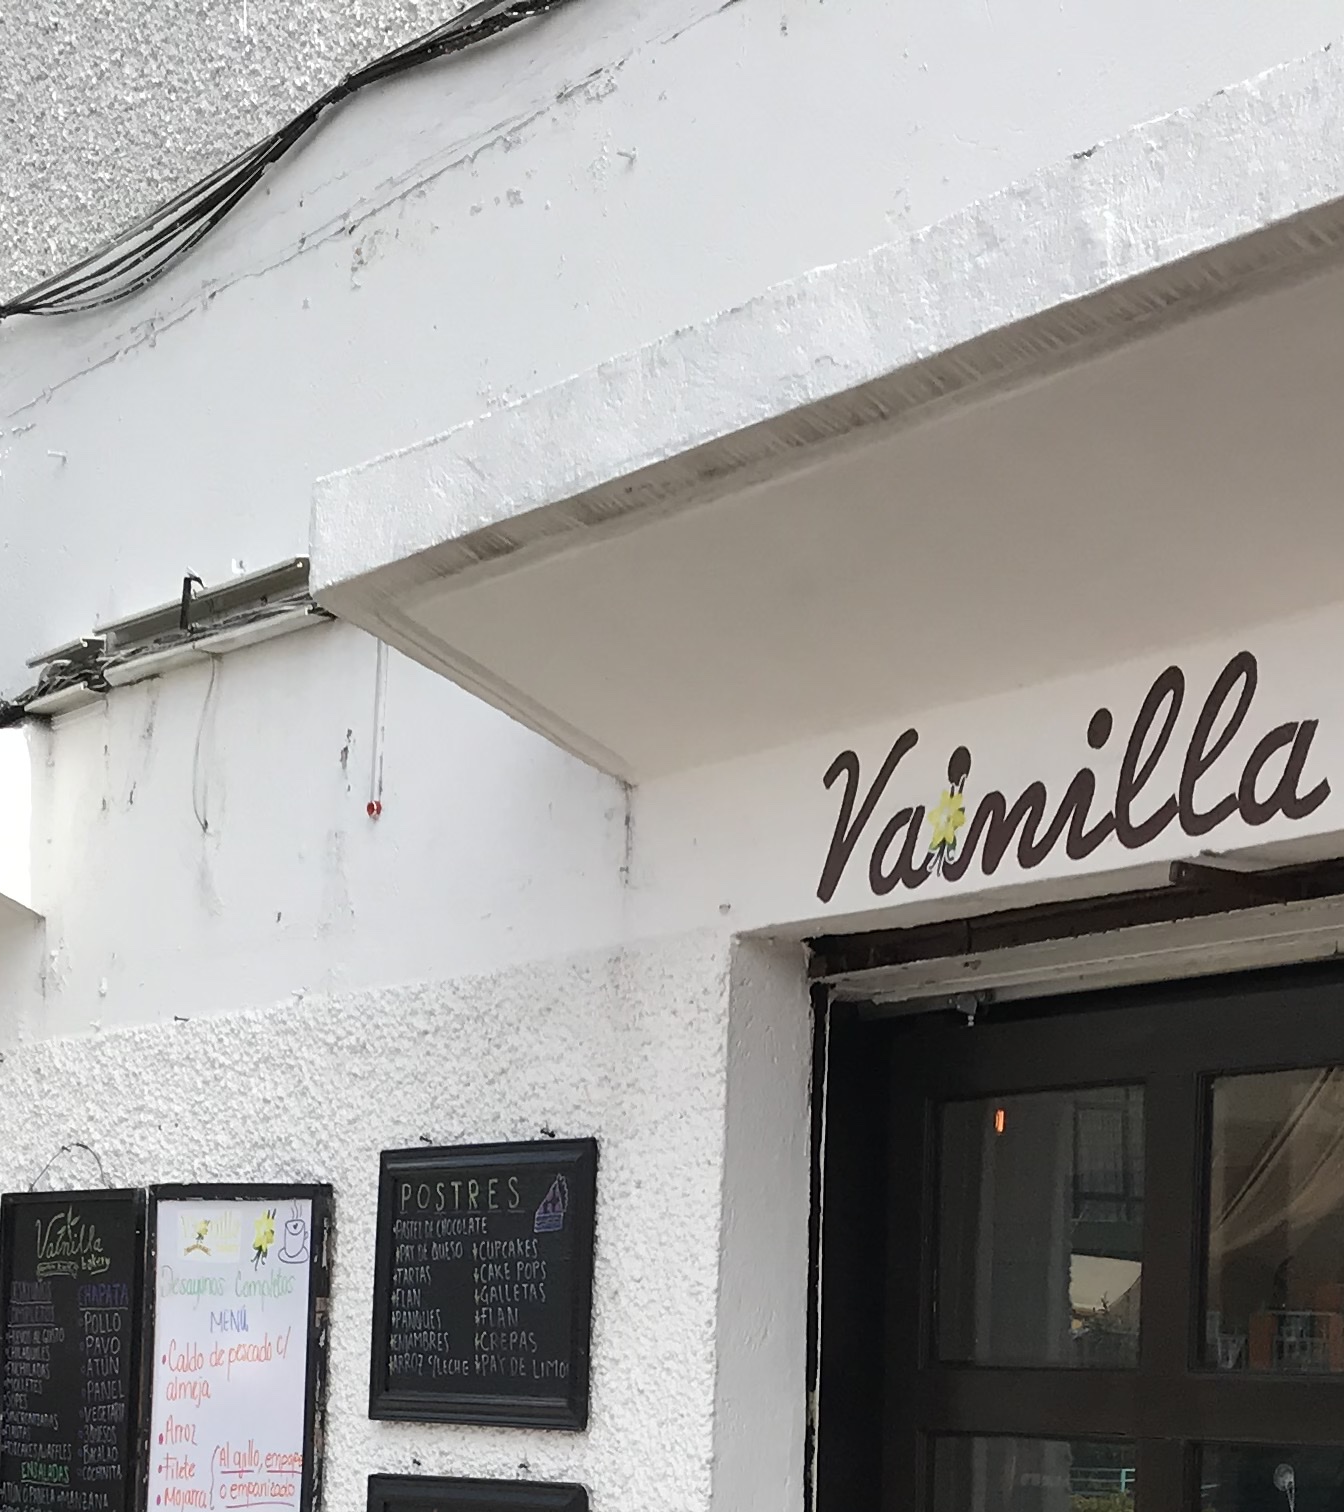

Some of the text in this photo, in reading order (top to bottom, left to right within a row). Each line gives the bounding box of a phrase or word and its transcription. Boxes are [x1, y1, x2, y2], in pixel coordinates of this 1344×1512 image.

[816, 650, 1332, 903] Vainilla
[401, 1176, 521, 1212] POSTRES
[436, 1217, 488, 1237] CHOCOLATE
[431, 1240, 464, 1261] QUESO
[479, 1238, 539, 1261] CUPCAKES
[397, 1265, 432, 1285] TARTAS
[480, 1260, 547, 1283] CAKE POPS
[396, 1288, 422, 1308] FLAN
[480, 1282, 547, 1305] GALLETAS
[84, 1311, 121, 1334] POLLO
[480, 1307, 520, 1327] FLAN
[86, 1335, 121, 1356] PAVO
[480, 1331, 538, 1353] CREPAS
[168, 1339, 204, 1372] Caldo
[210, 1341, 224, 1366] de
[228, 1333, 272, 1381] pescado
[482, 1354, 507, 1377] PAY
[510, 1357, 527, 1377] DE
[166, 1376, 211, 1408] almeja
[165, 1415, 197, 1446] Arroz
[163, 1453, 196, 1480] Filete
[219, 1441, 230, 1469] Al
[230, 1478, 295, 1507] empanizado
